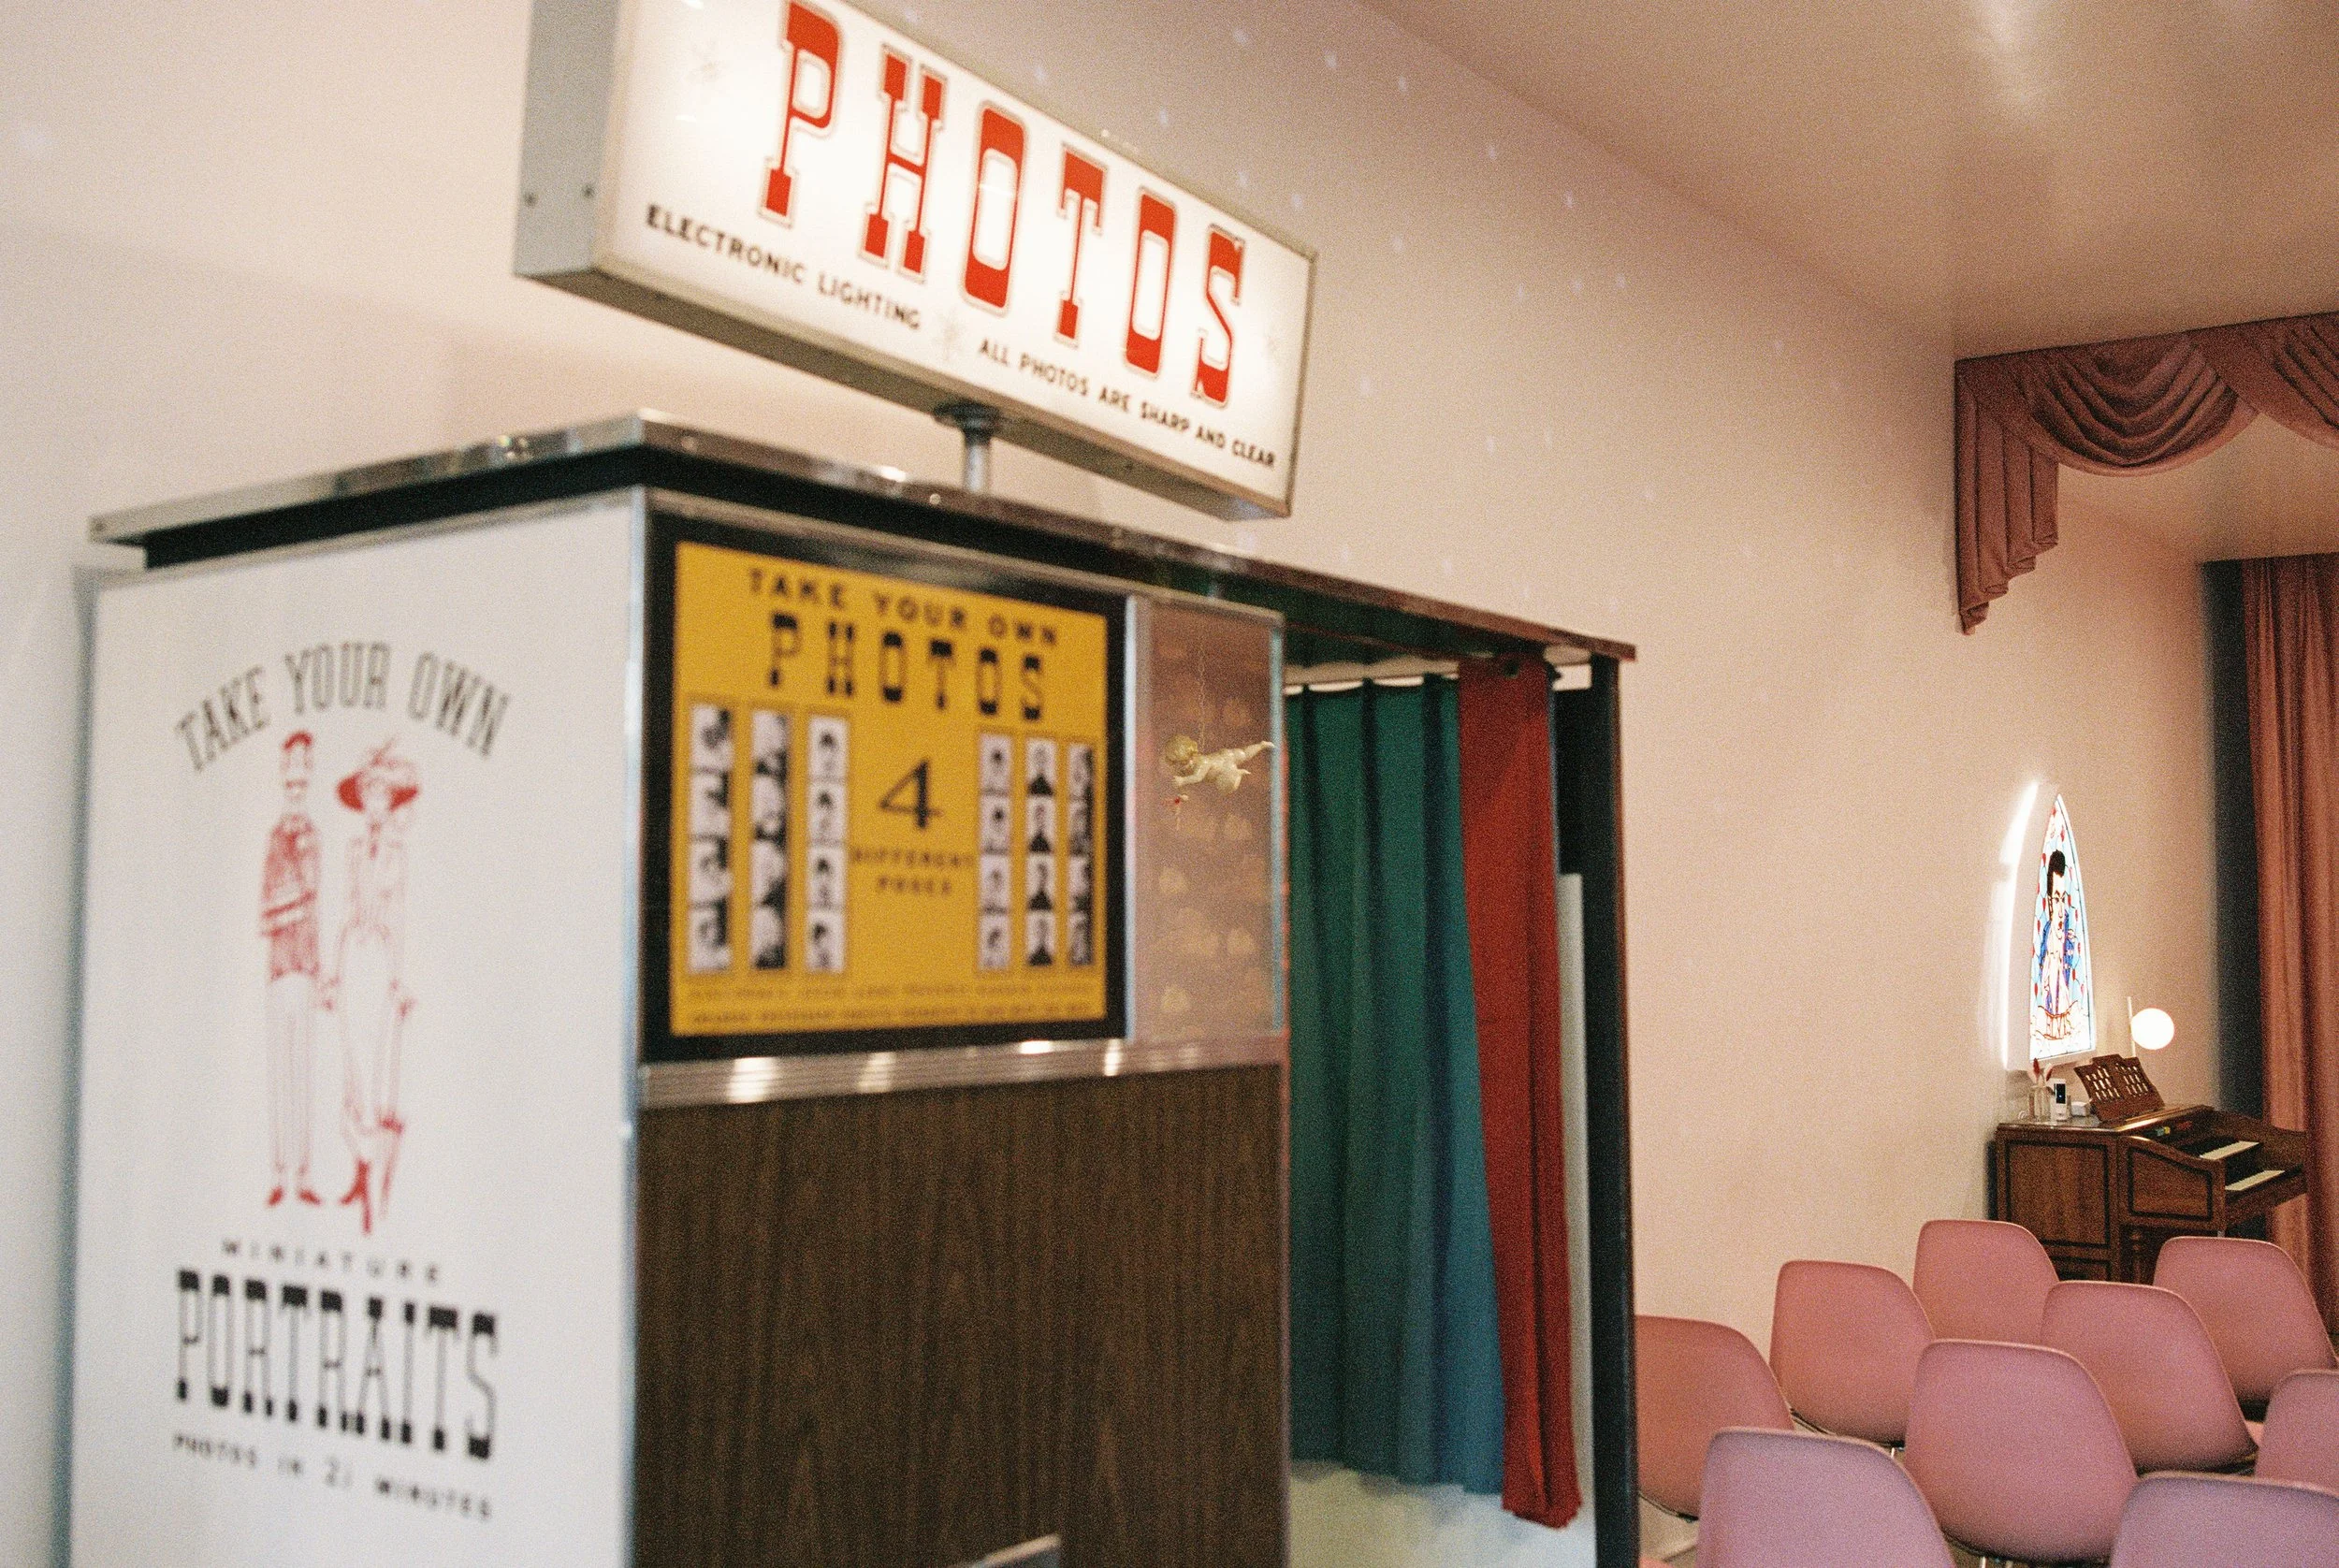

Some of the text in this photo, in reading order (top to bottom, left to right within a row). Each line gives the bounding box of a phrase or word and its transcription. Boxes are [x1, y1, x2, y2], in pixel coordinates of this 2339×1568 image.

[761, 0, 1245, 408] PHOTOS
[647, 204, 921, 329] ELECTRONIC LIGHTING
[980, 338, 1276, 468] ALL PHOTOS ARE SHARP AND CLEAR
[751, 567, 1057, 647] TAKE YOUR OWN
[767, 610, 1043, 721] PHOTOS
[175, 642, 512, 773] TAKE YOUR OWN
[878, 759, 944, 830] 4
[223, 1239, 440, 1285] MINIATURE
[175, 1268, 499, 1461] PORTRAITS
[173, 1431, 258, 1469] PHOTOS
[376, 1477, 493, 1521] MINUTES
